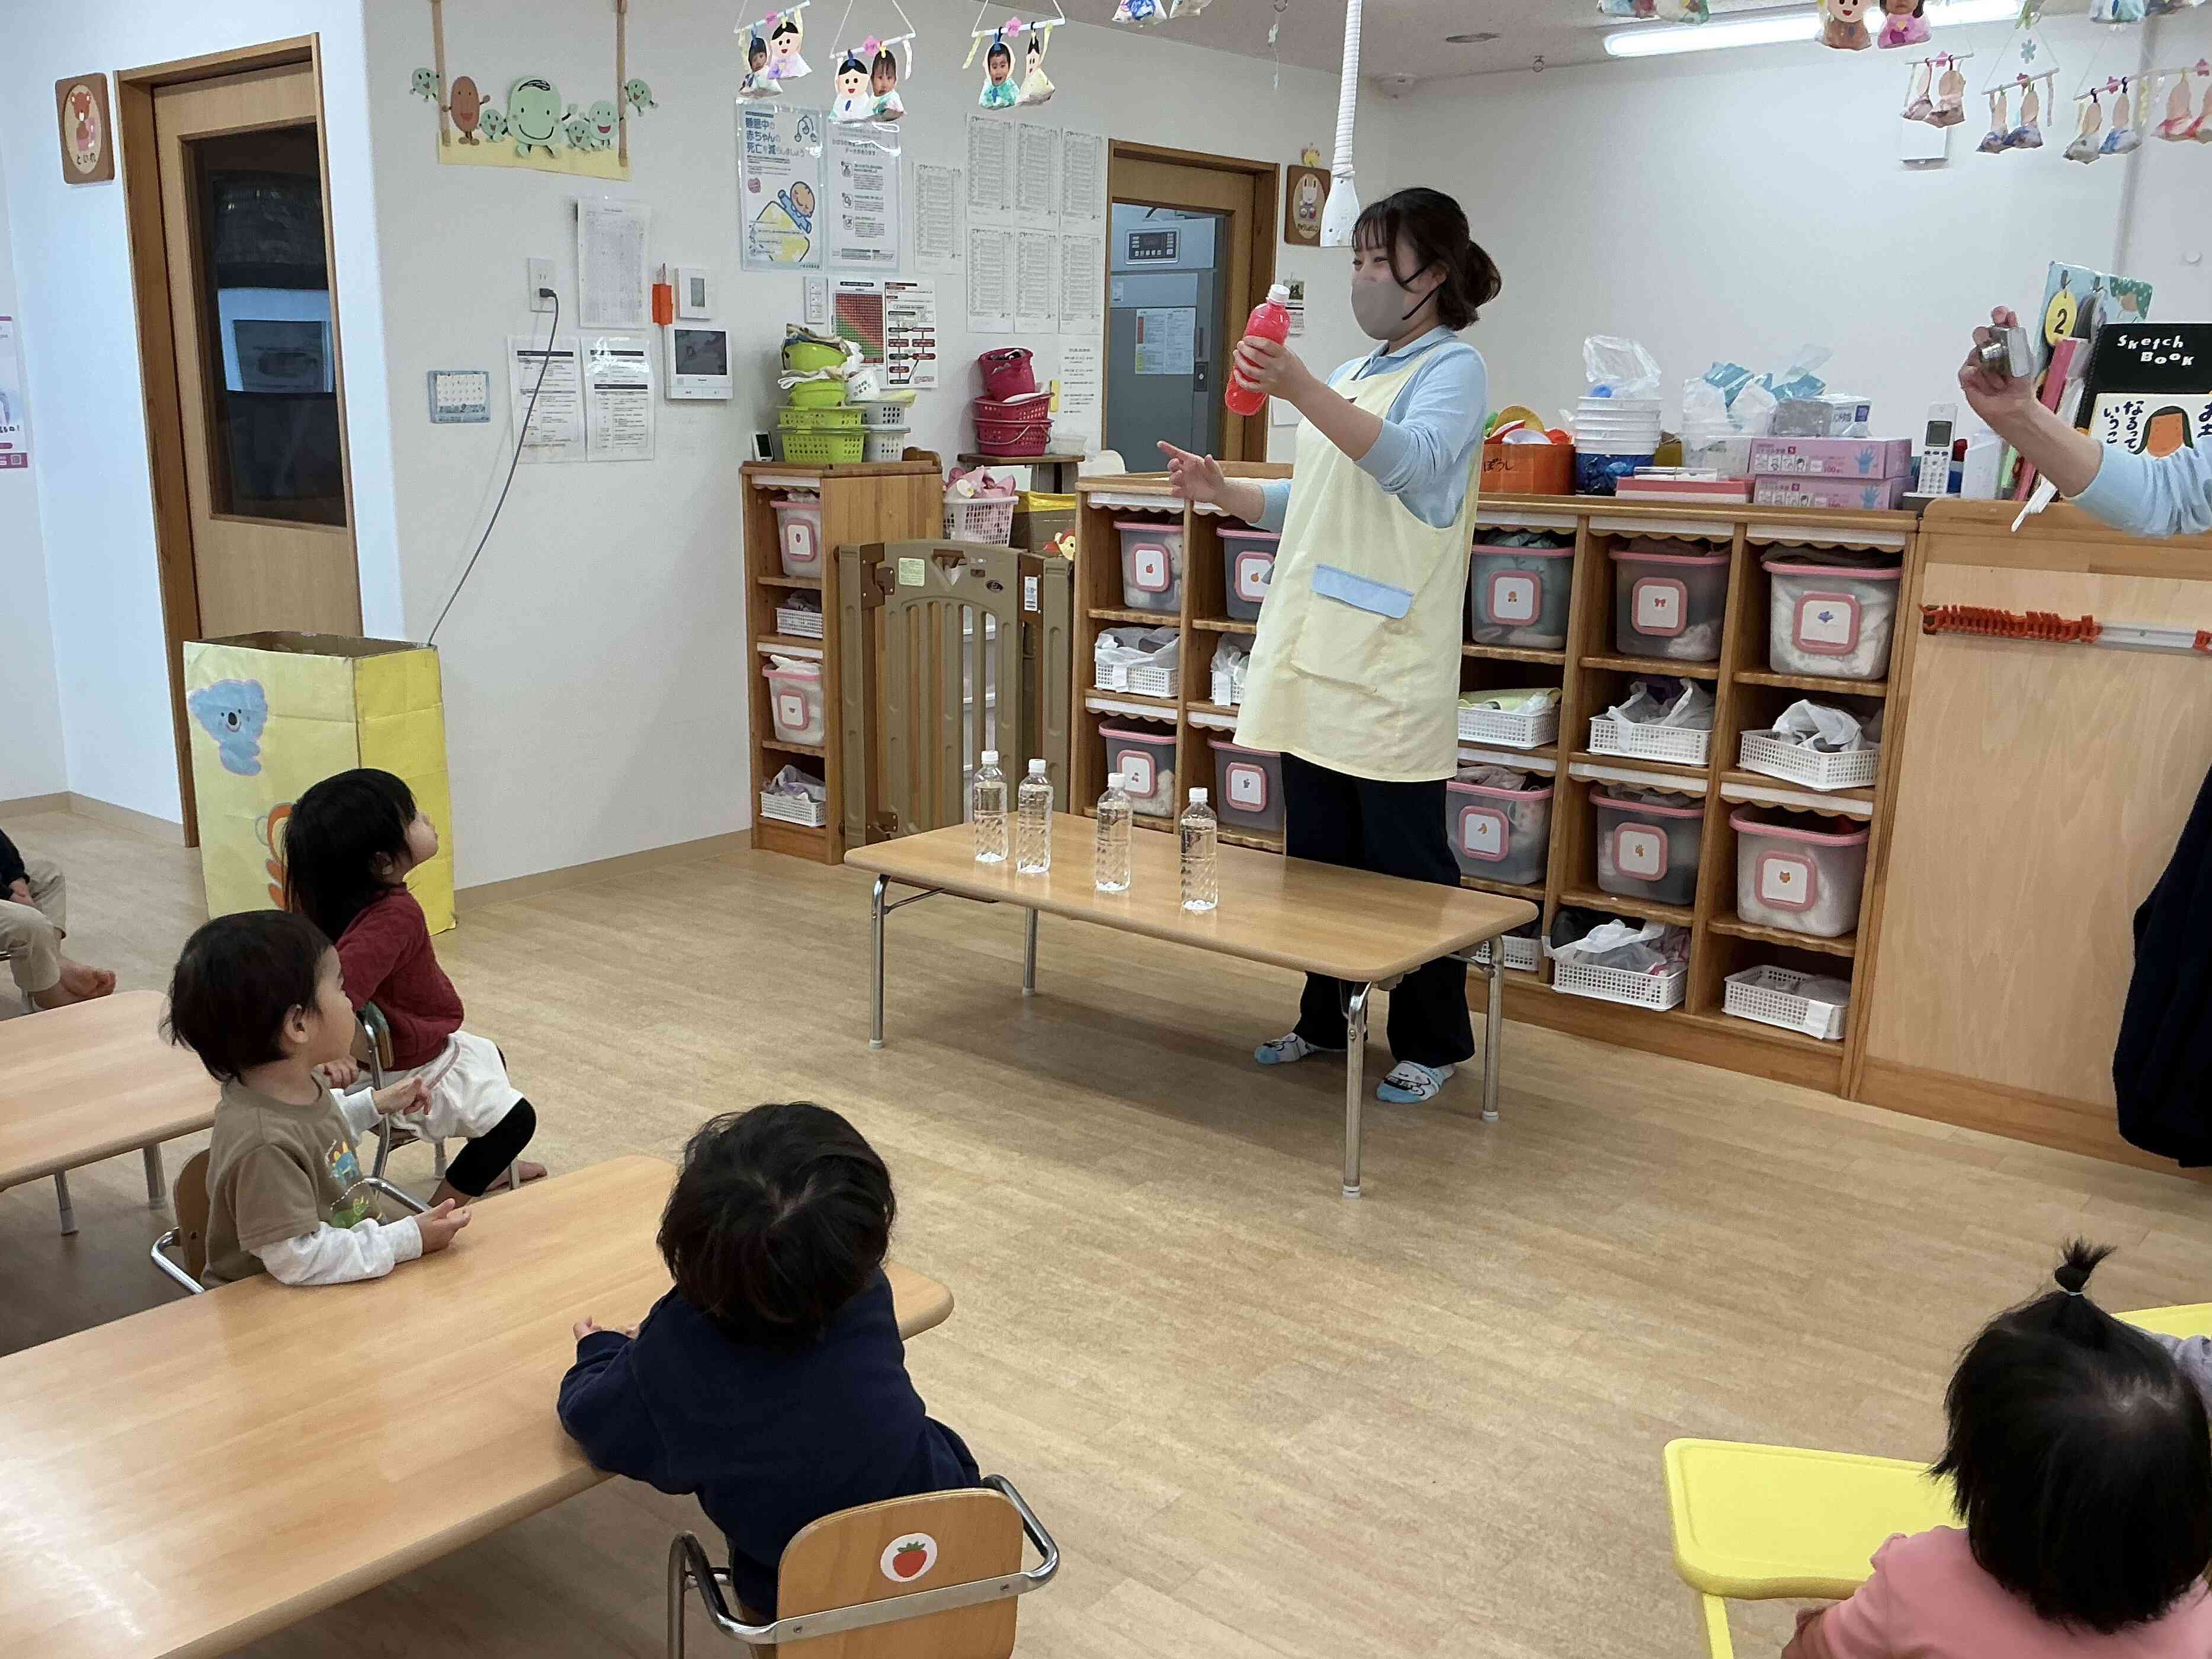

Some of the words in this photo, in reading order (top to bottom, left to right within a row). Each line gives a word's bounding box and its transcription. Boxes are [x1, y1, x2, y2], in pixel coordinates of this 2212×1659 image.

[2053, 308, 2067, 335] 2
[2123, 401, 2144, 449] なるって
[1484, 458, 1515, 472] ぼうし
